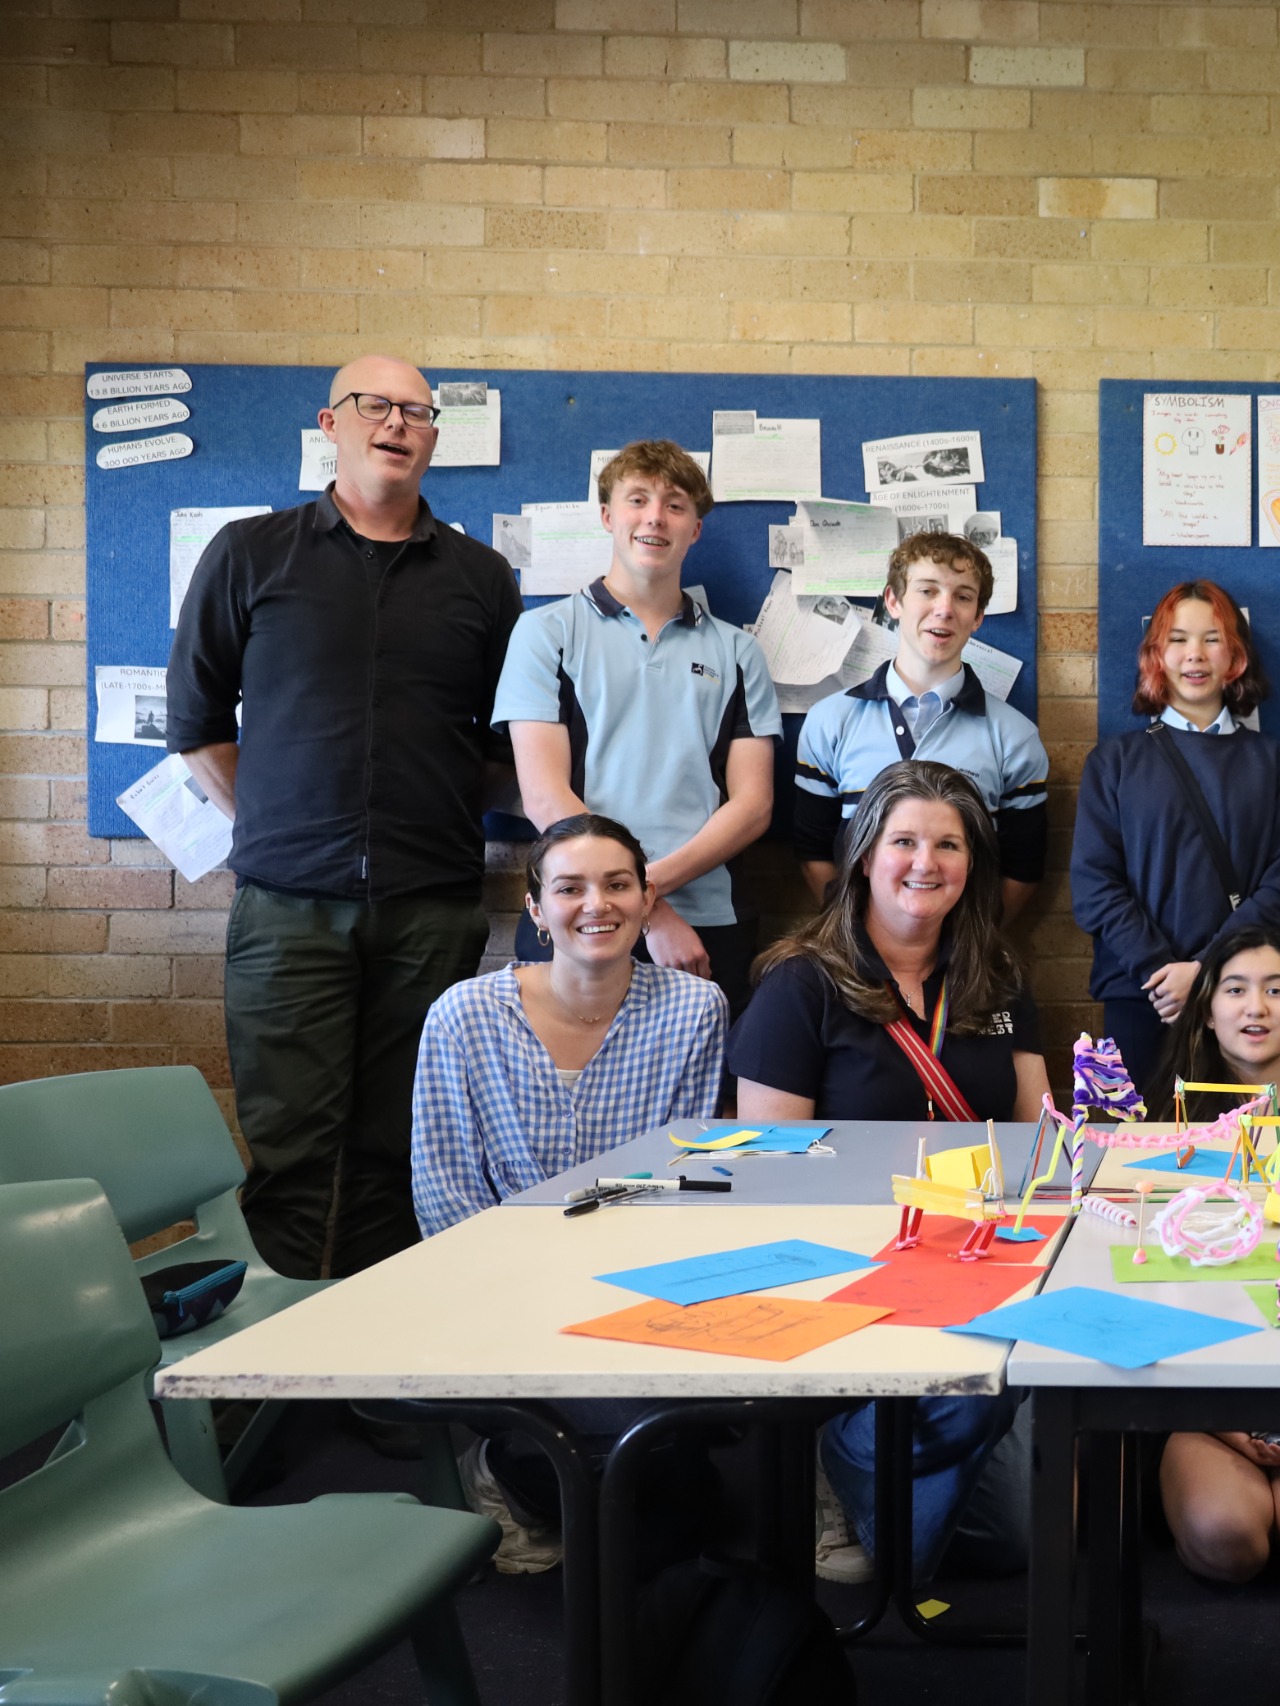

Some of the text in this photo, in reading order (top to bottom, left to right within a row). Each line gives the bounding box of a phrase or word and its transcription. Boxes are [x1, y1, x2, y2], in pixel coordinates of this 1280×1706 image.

[102, 373, 140, 382] UNIVERSE
[110, 386, 142, 394] BILLION
[144, 384, 170, 392] YEARS
[172, 382, 190, 390] AGO
[107, 400, 170, 414] EARTH FORMED
[1154, 396, 1225, 408] SYMBOLISM
[110, 418, 140, 427] BILLION
[143, 414, 169, 422] YEARS
[172, 410, 188, 418] AGO
[108, 436, 176, 454] HUMANS EVOLVE
[865, 440, 921, 453] RENAISSANCE
[104, 448, 186, 468] 300 000 YEARS AGO
[872, 488, 970, 502] AGE OF ENLIGHTENMENT
